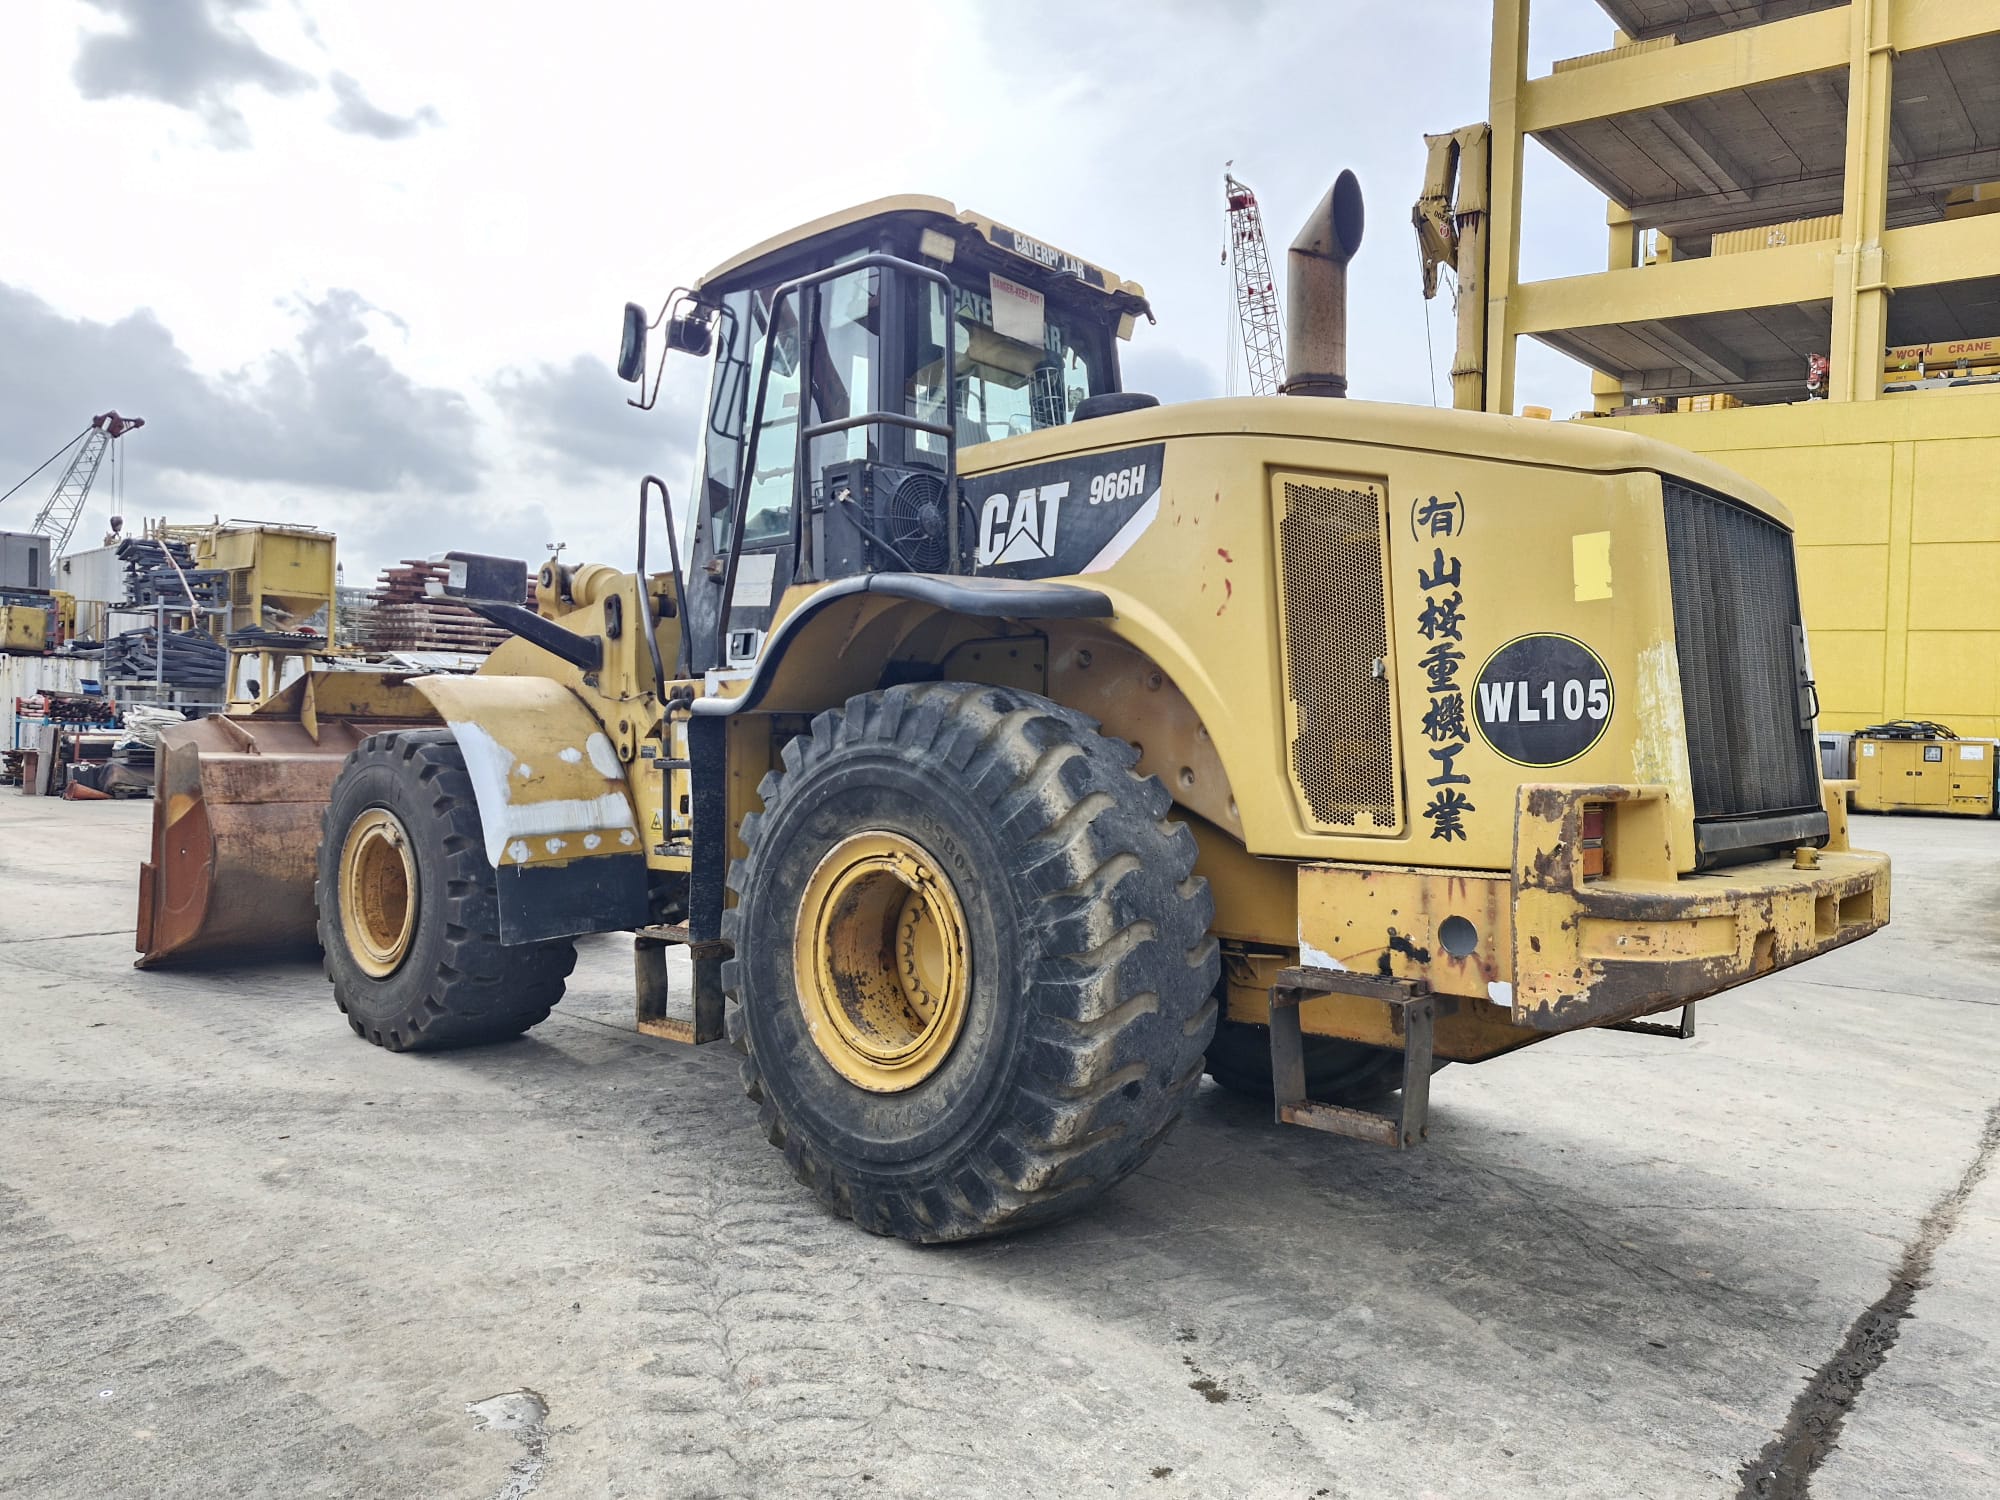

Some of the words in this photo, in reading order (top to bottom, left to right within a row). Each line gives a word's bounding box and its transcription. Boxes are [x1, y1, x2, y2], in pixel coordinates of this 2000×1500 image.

[1948, 341, 1992, 353] CRANE
[1089, 464, 1146, 505] 966H
[979, 481, 1070, 566] CAT
[1479, 679, 1609, 722] WL105
